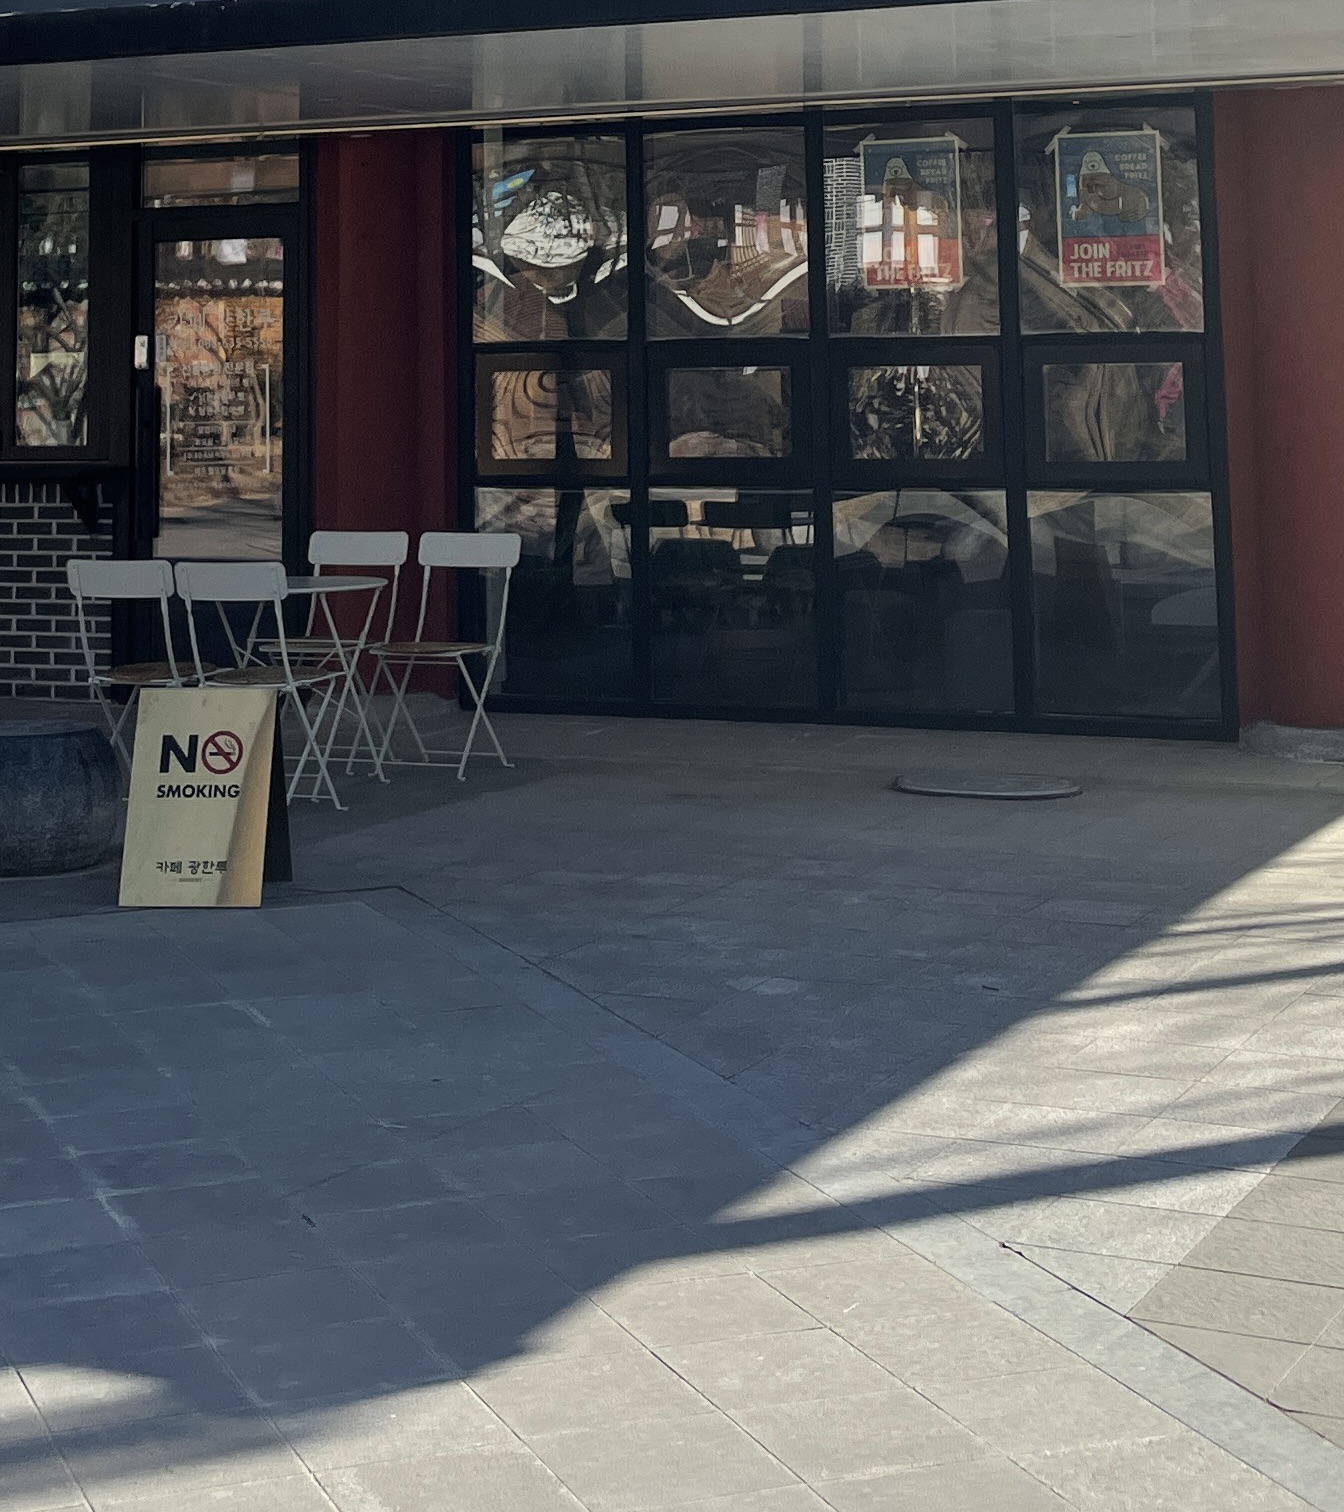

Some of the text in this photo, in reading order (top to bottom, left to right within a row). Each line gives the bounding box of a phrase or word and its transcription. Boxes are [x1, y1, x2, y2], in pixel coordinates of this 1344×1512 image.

[1070, 242, 1110, 261] JOIN
[1069, 260, 1154, 278] THE FRITZ
[156, 784, 241, 799] SMOKING
[155, 860, 228, 875] 카페 광한루
